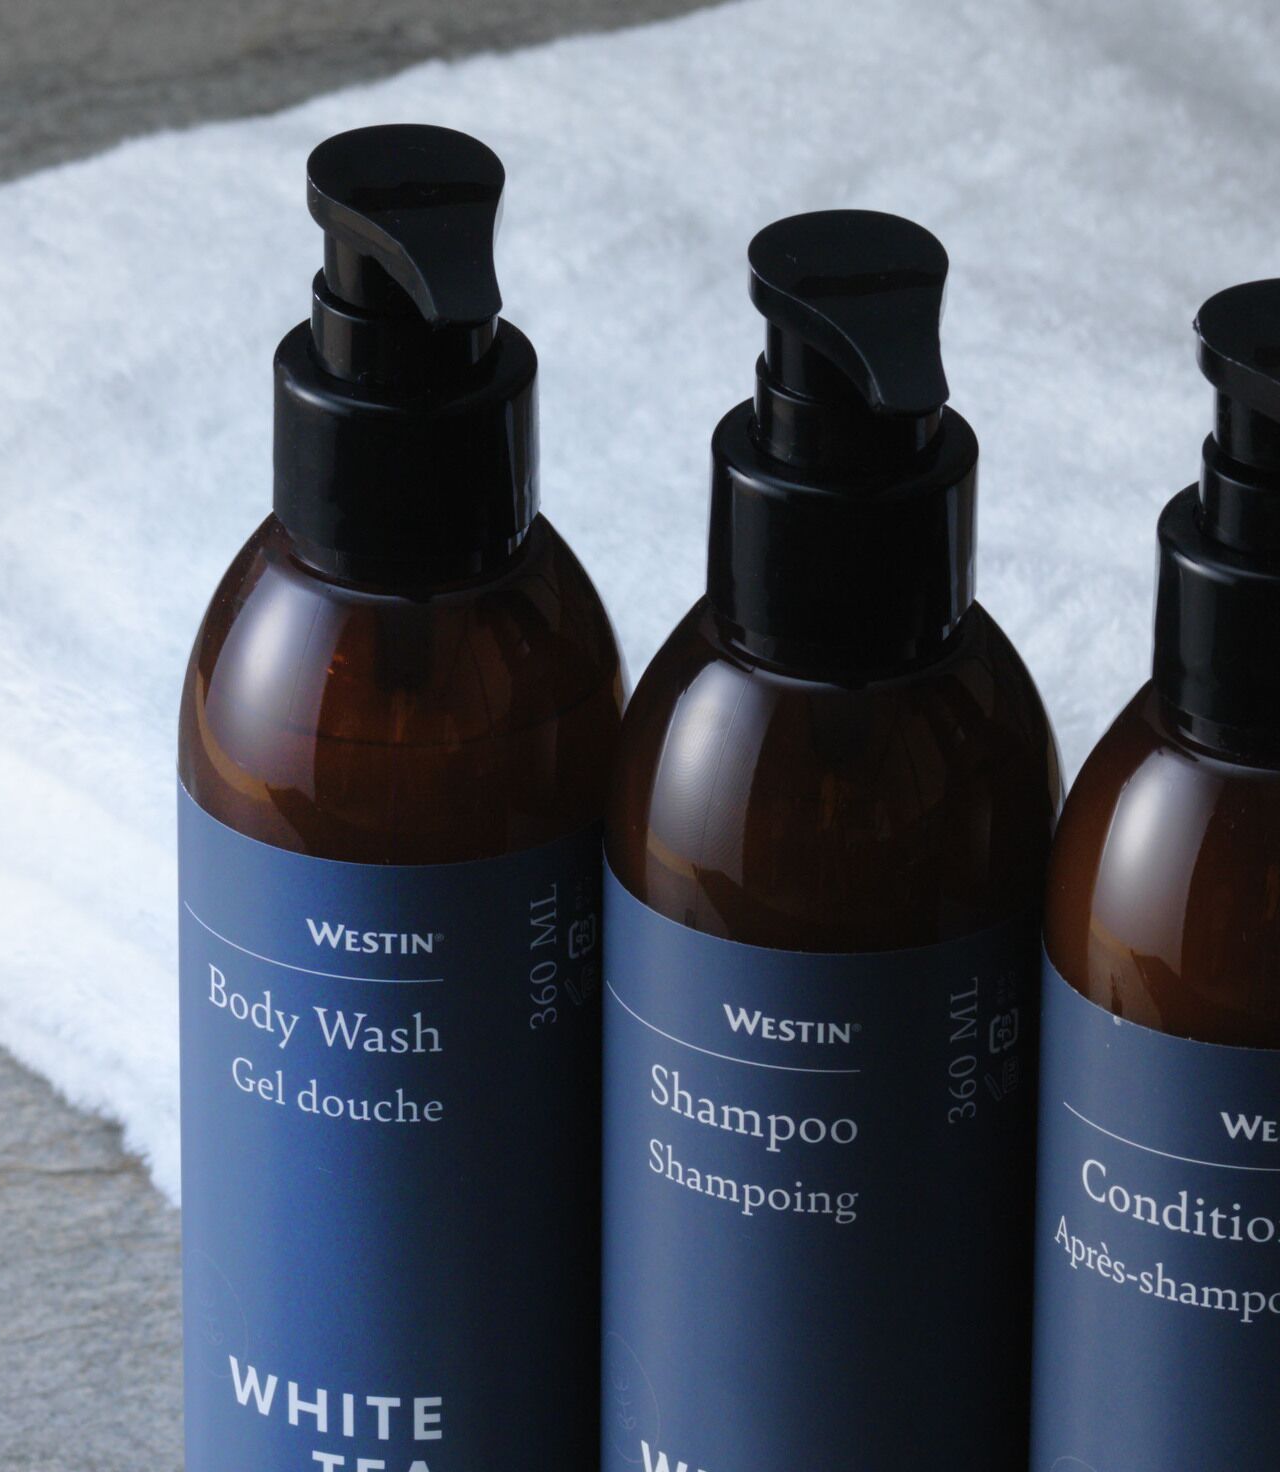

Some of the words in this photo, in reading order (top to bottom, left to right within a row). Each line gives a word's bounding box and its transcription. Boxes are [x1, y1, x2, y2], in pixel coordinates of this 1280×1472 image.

[529, 882, 559, 951] ML
[208, 963, 299, 1049] Body
[313, 1005, 443, 1054] Wash
[529, 960, 559, 1030] 360
[949, 976, 979, 1044] ML
[231, 1057, 286, 1106] Gel
[297, 1079, 444, 1123] douche
[650, 1064, 858, 1152] Shampoo
[948, 1055, 978, 1124] 360
[649, 1138, 859, 1224] Shampoing
[229, 1355, 442, 1440] WHITE
